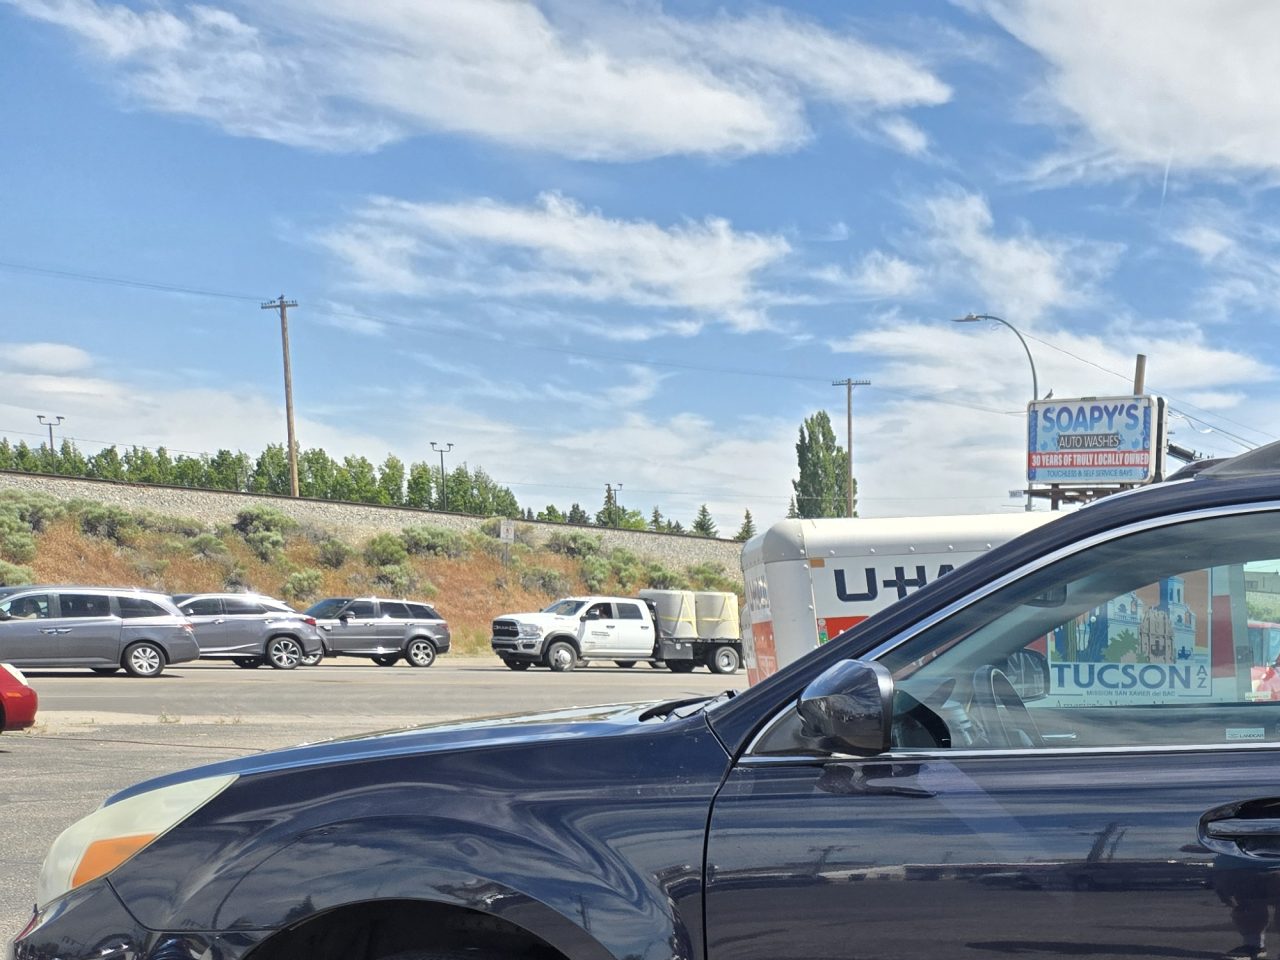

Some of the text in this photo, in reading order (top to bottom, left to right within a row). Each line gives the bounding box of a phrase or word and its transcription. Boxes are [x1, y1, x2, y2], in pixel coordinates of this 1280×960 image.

[1042, 404, 1140, 433] SOAPY'S
[1059, 434, 1120, 448] AUTO WASHES
[1032, 453, 1149, 466] 30 YEARS OF TRULY LOCALLY OWNED
[1051, 664, 1191, 689] TUCSON
